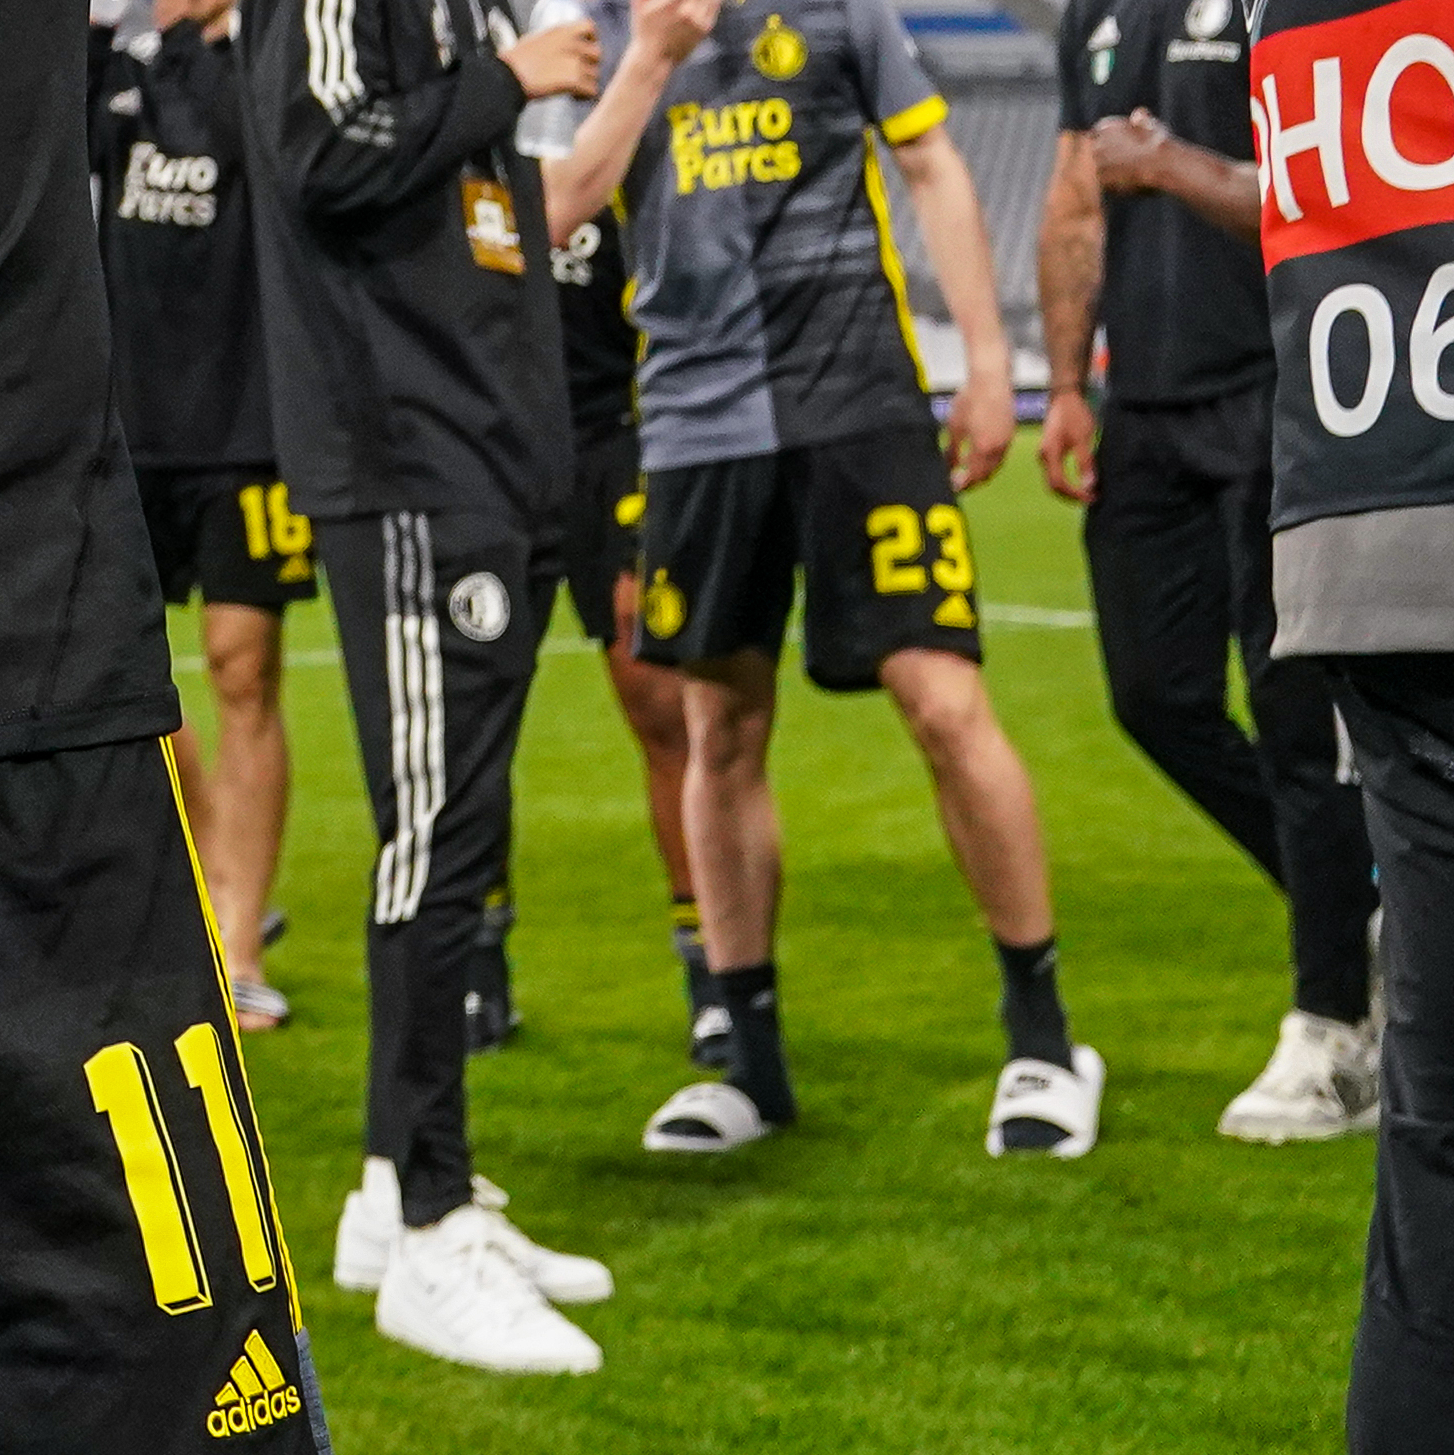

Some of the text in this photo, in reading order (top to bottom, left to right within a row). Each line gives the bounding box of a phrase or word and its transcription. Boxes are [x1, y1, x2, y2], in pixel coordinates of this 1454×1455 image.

[866, 503, 974, 596] 23
[82, 1021, 278, 1316] 11
[206, 1383, 302, 1439] adidas
